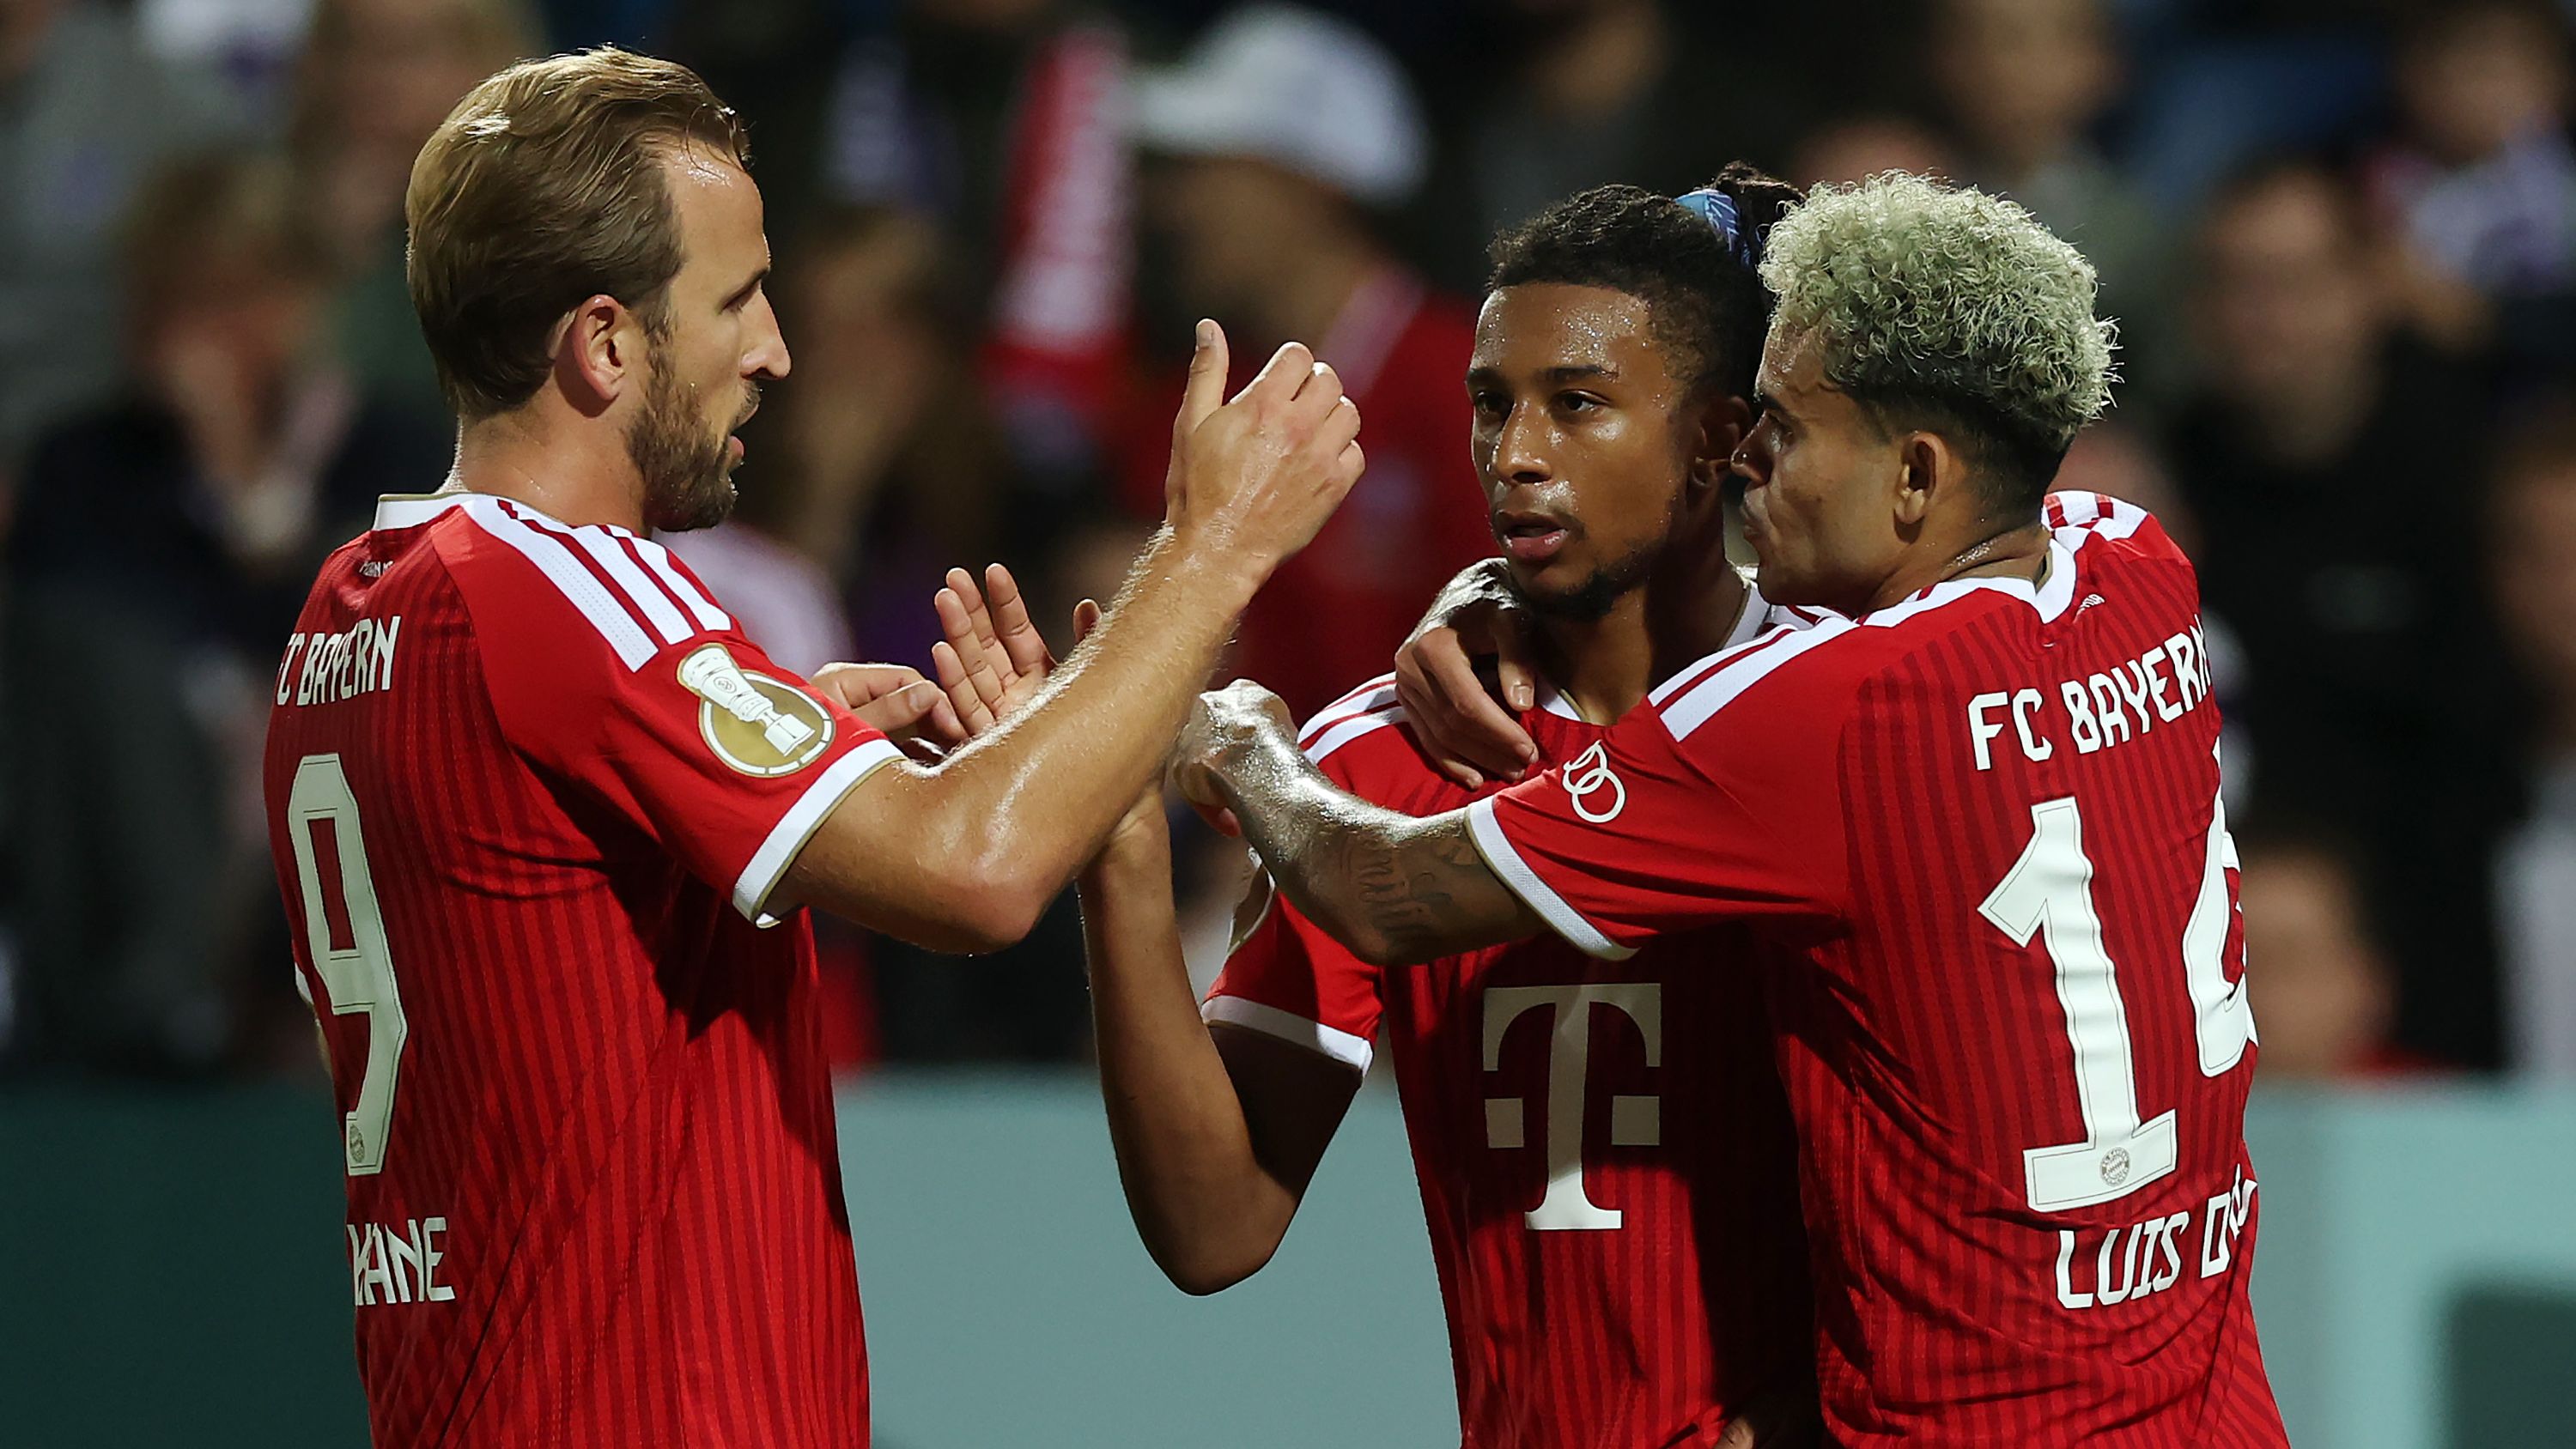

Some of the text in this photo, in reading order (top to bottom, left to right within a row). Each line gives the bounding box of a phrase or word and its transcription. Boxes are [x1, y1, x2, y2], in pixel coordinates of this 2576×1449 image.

[296, 615, 401, 706] BAYERN
[1967, 613, 2212, 771] FC BAYERN
[288, 752, 407, 1176] 9
[1483, 983, 1662, 1230] T
[346, 1216, 456, 1306] KANE
[2056, 1211, 2190, 1309] LUIS
